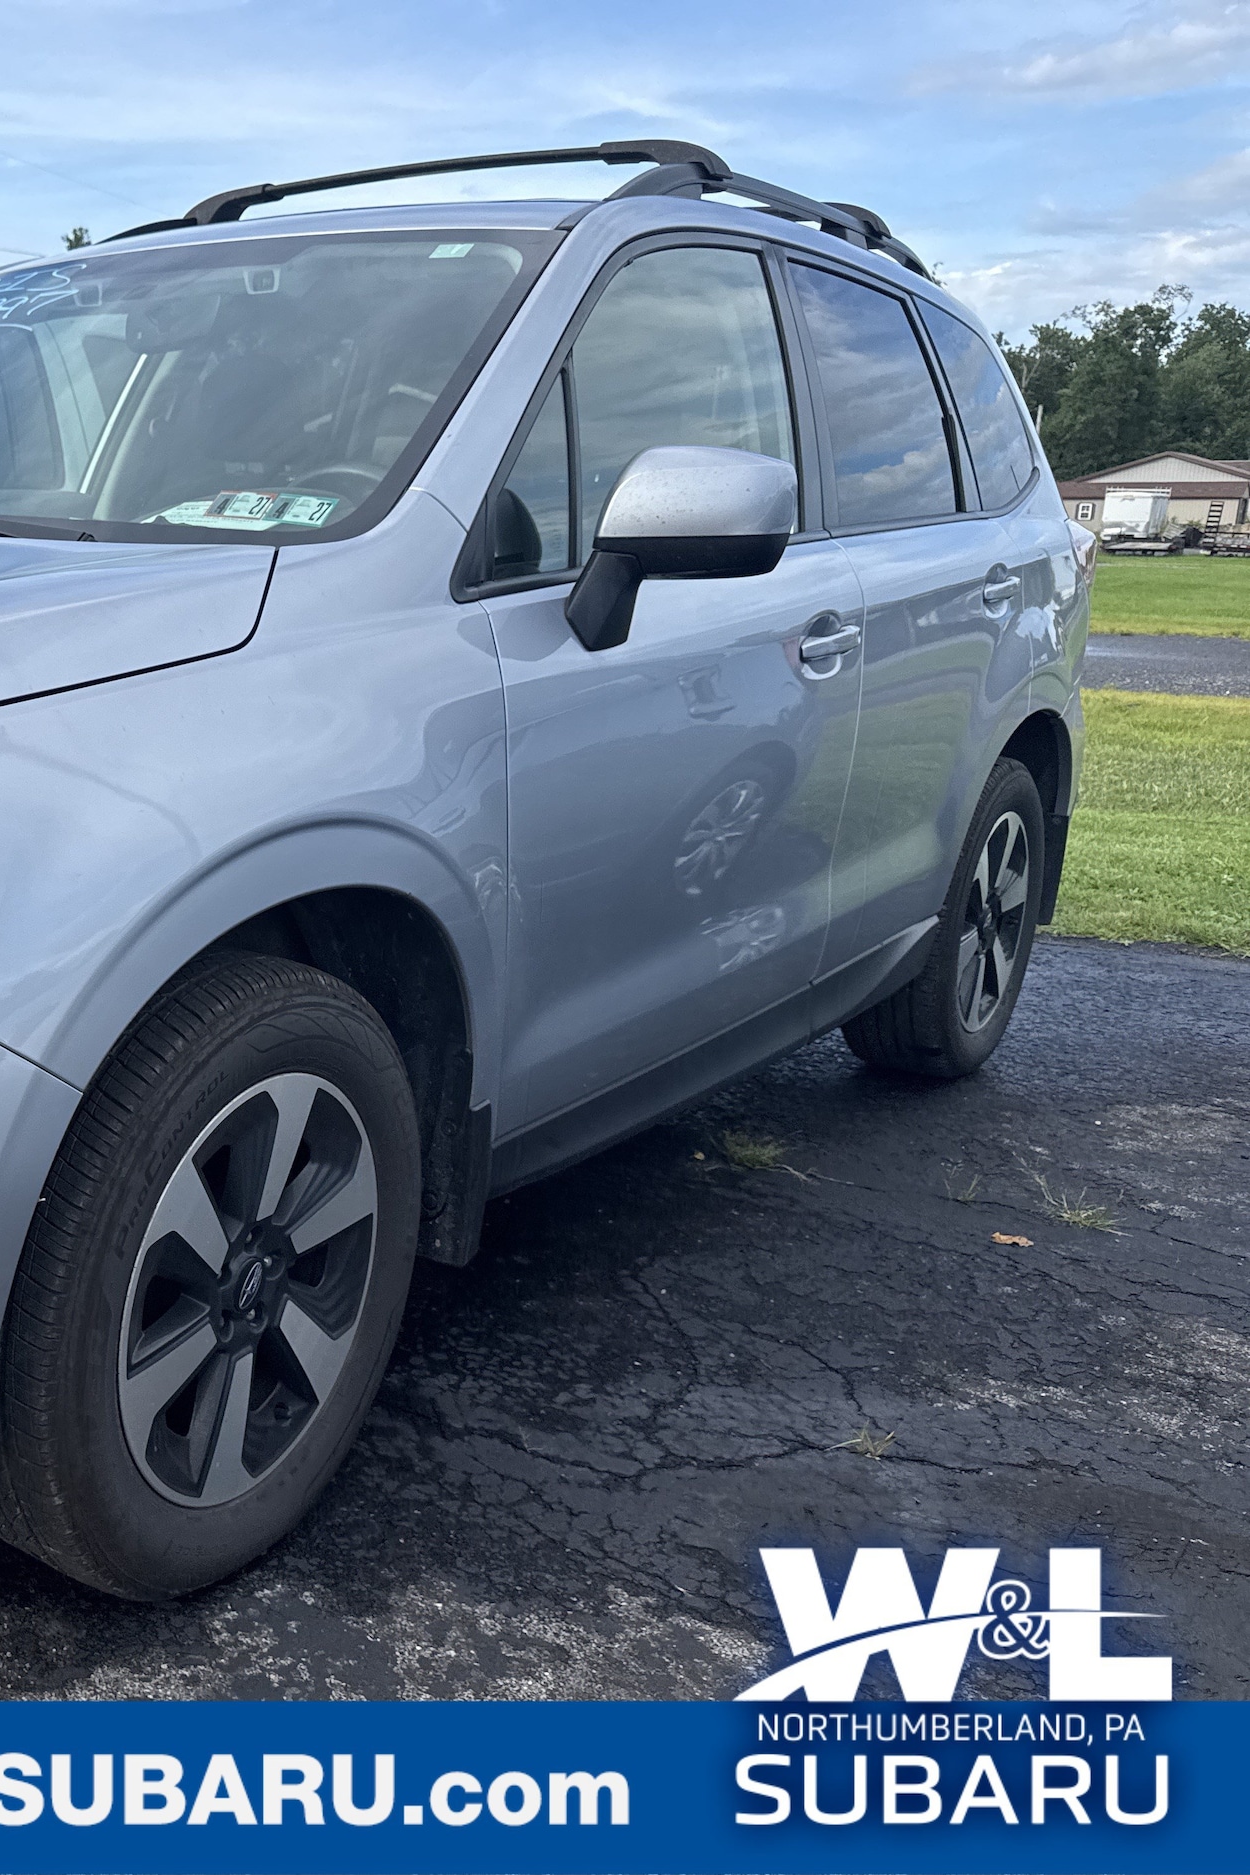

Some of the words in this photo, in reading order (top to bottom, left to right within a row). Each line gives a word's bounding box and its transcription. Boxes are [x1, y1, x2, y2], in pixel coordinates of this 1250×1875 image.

[214, 498, 231, 515] 4
[248, 497, 271, 517] 27
[273, 501, 290, 519] 4
[308, 502, 332, 522] 27
